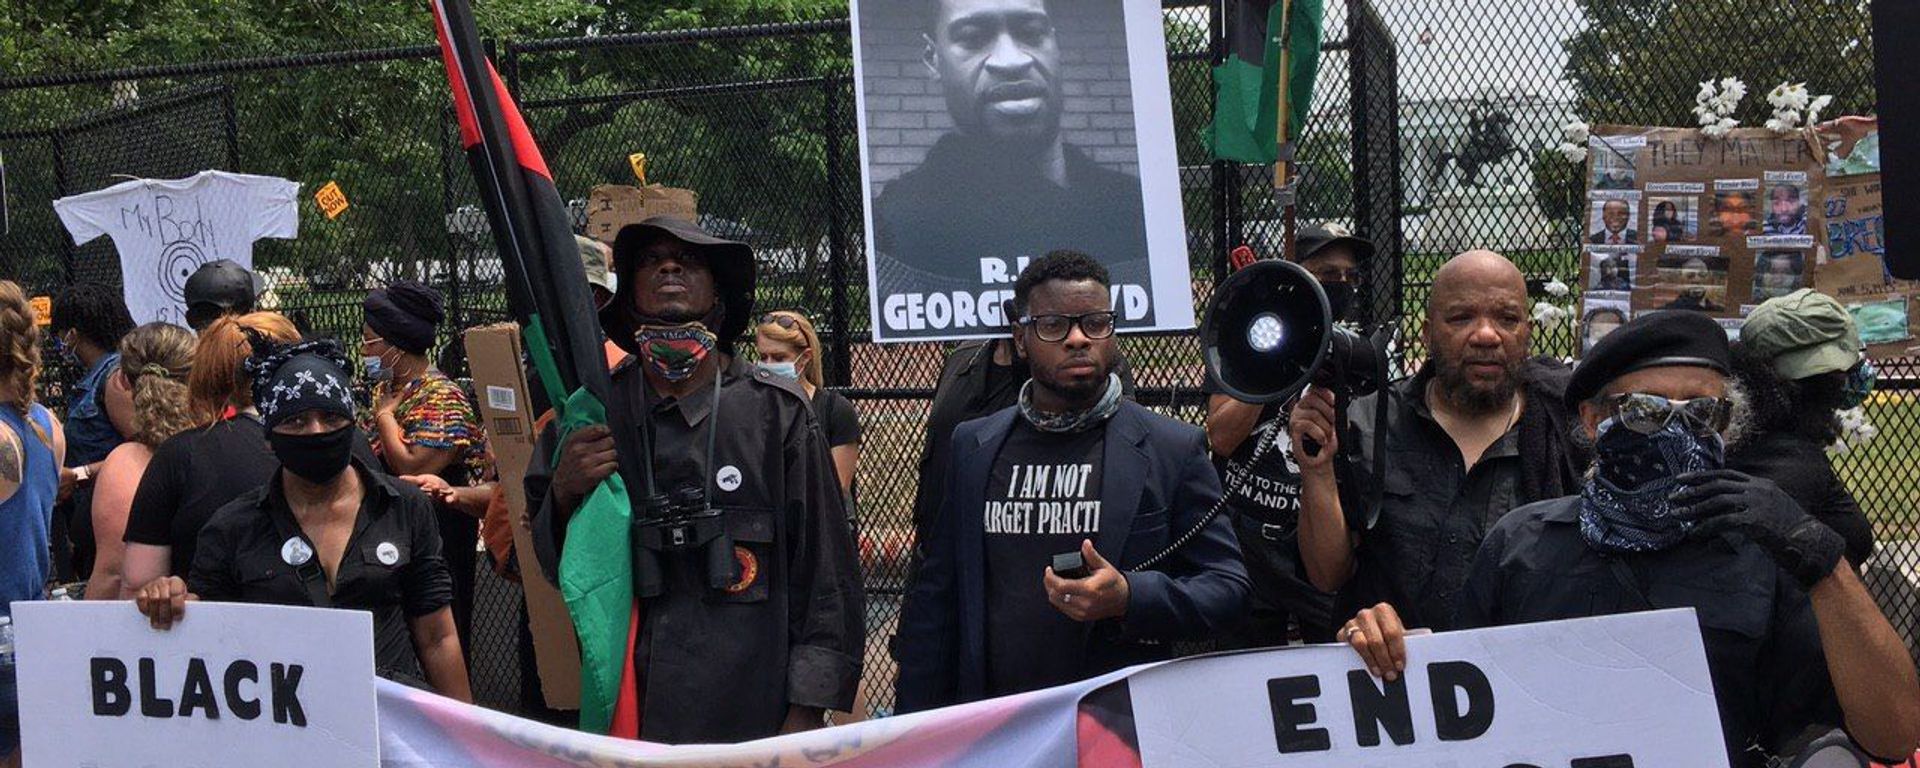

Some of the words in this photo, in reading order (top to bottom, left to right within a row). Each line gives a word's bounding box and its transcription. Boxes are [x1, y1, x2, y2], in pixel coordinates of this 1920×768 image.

[1647, 138, 1707, 167] THEY
[121, 203, 153, 238] My
[155, 194, 219, 263] Body
[1007, 465, 1020, 498] I
[1020, 465, 1051, 499] AM
[1051, 464, 1093, 498] NOT
[1256, 476, 1270, 489] TO
[1273, 481, 1297, 495] THE
[1253, 491, 1288, 510] AND
[90, 657, 307, 727] BLACK
[1267, 660, 1495, 754] END
